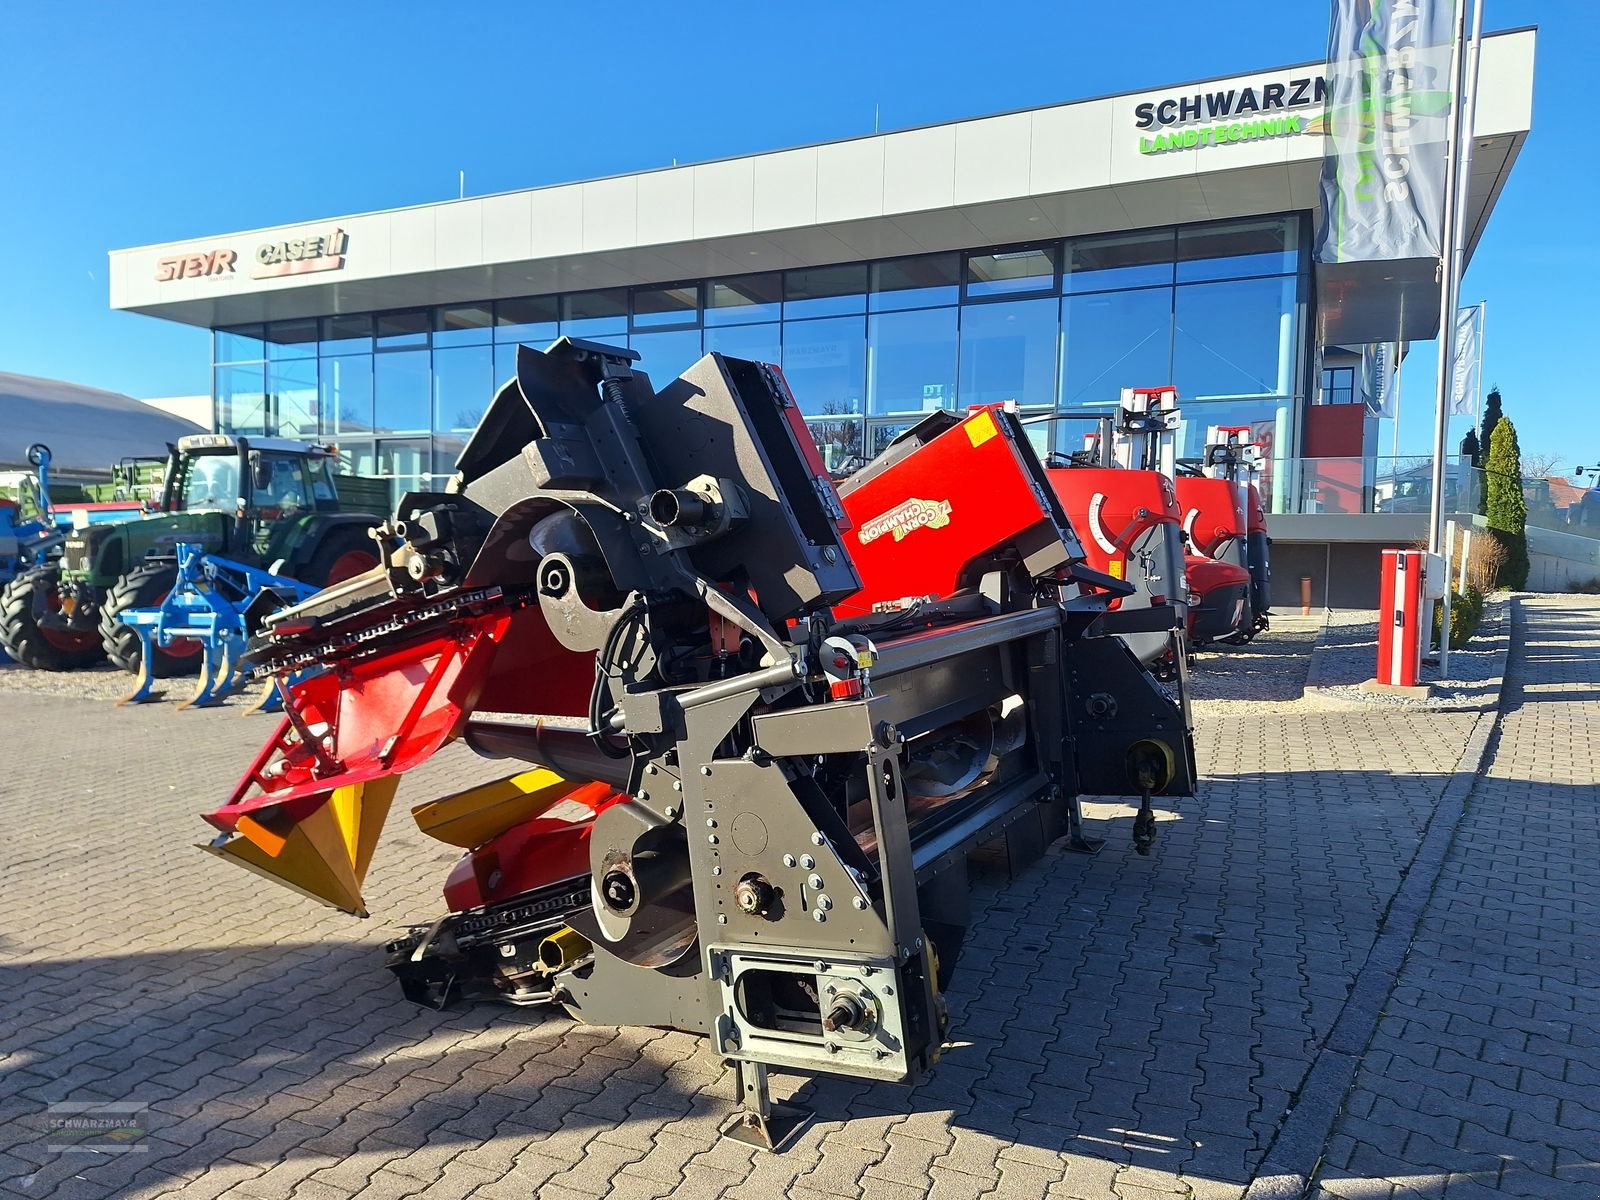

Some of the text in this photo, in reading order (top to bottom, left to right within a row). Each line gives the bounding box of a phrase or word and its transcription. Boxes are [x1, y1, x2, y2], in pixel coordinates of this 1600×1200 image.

[1139, 115, 1301, 154] LANDTECHNIK
[155, 249, 237, 281] STEYR
[255, 236, 322, 265] CASE
[859, 504, 922, 543] CHAMPION
[903, 509, 936, 534] CORN
